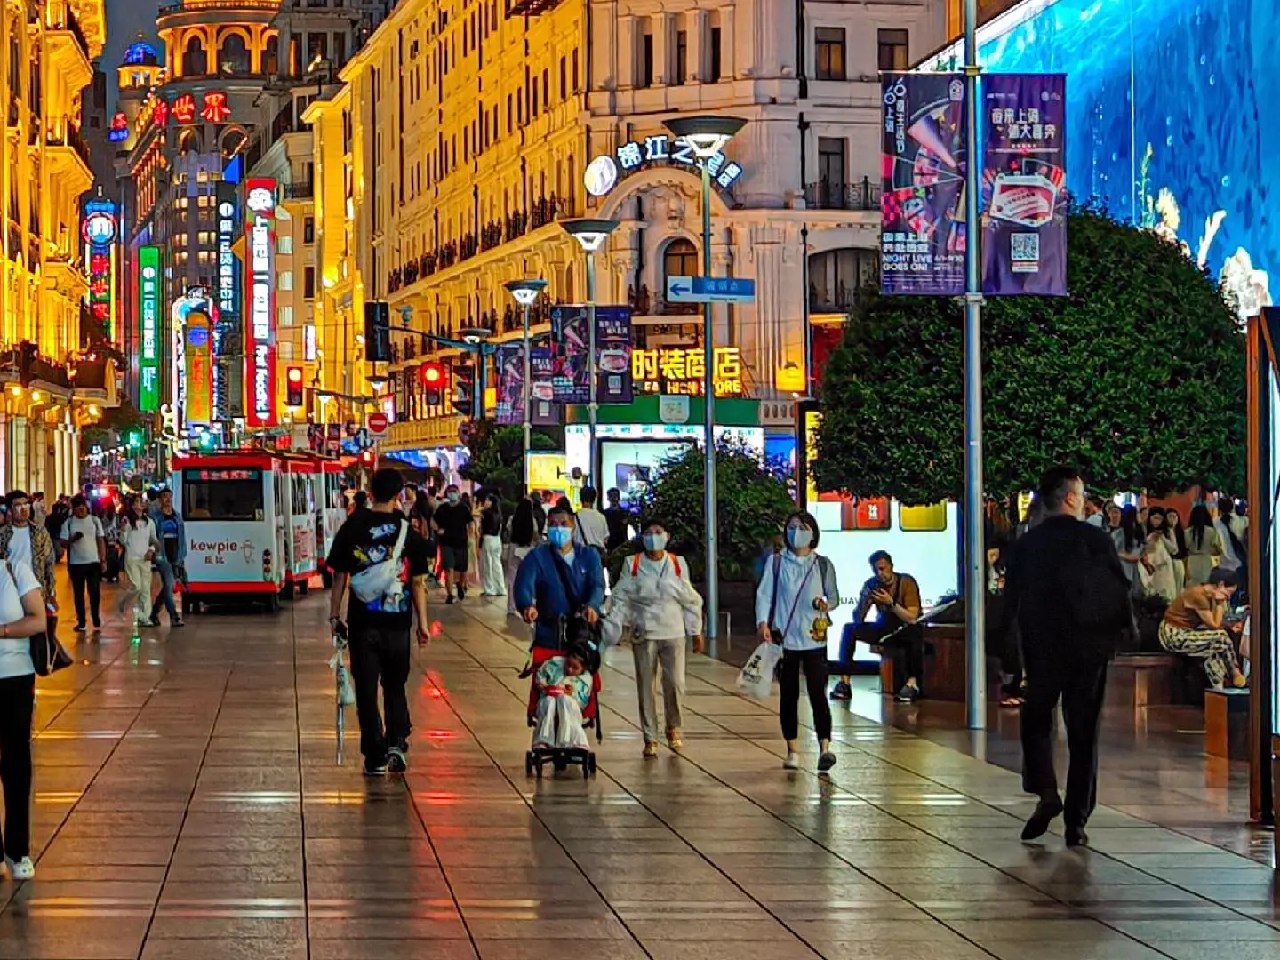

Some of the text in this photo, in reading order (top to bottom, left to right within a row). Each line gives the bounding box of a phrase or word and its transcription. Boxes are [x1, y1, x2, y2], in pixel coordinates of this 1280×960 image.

[631, 347, 741, 380] 时装商店
[190, 538, 238, 555] kewpie
